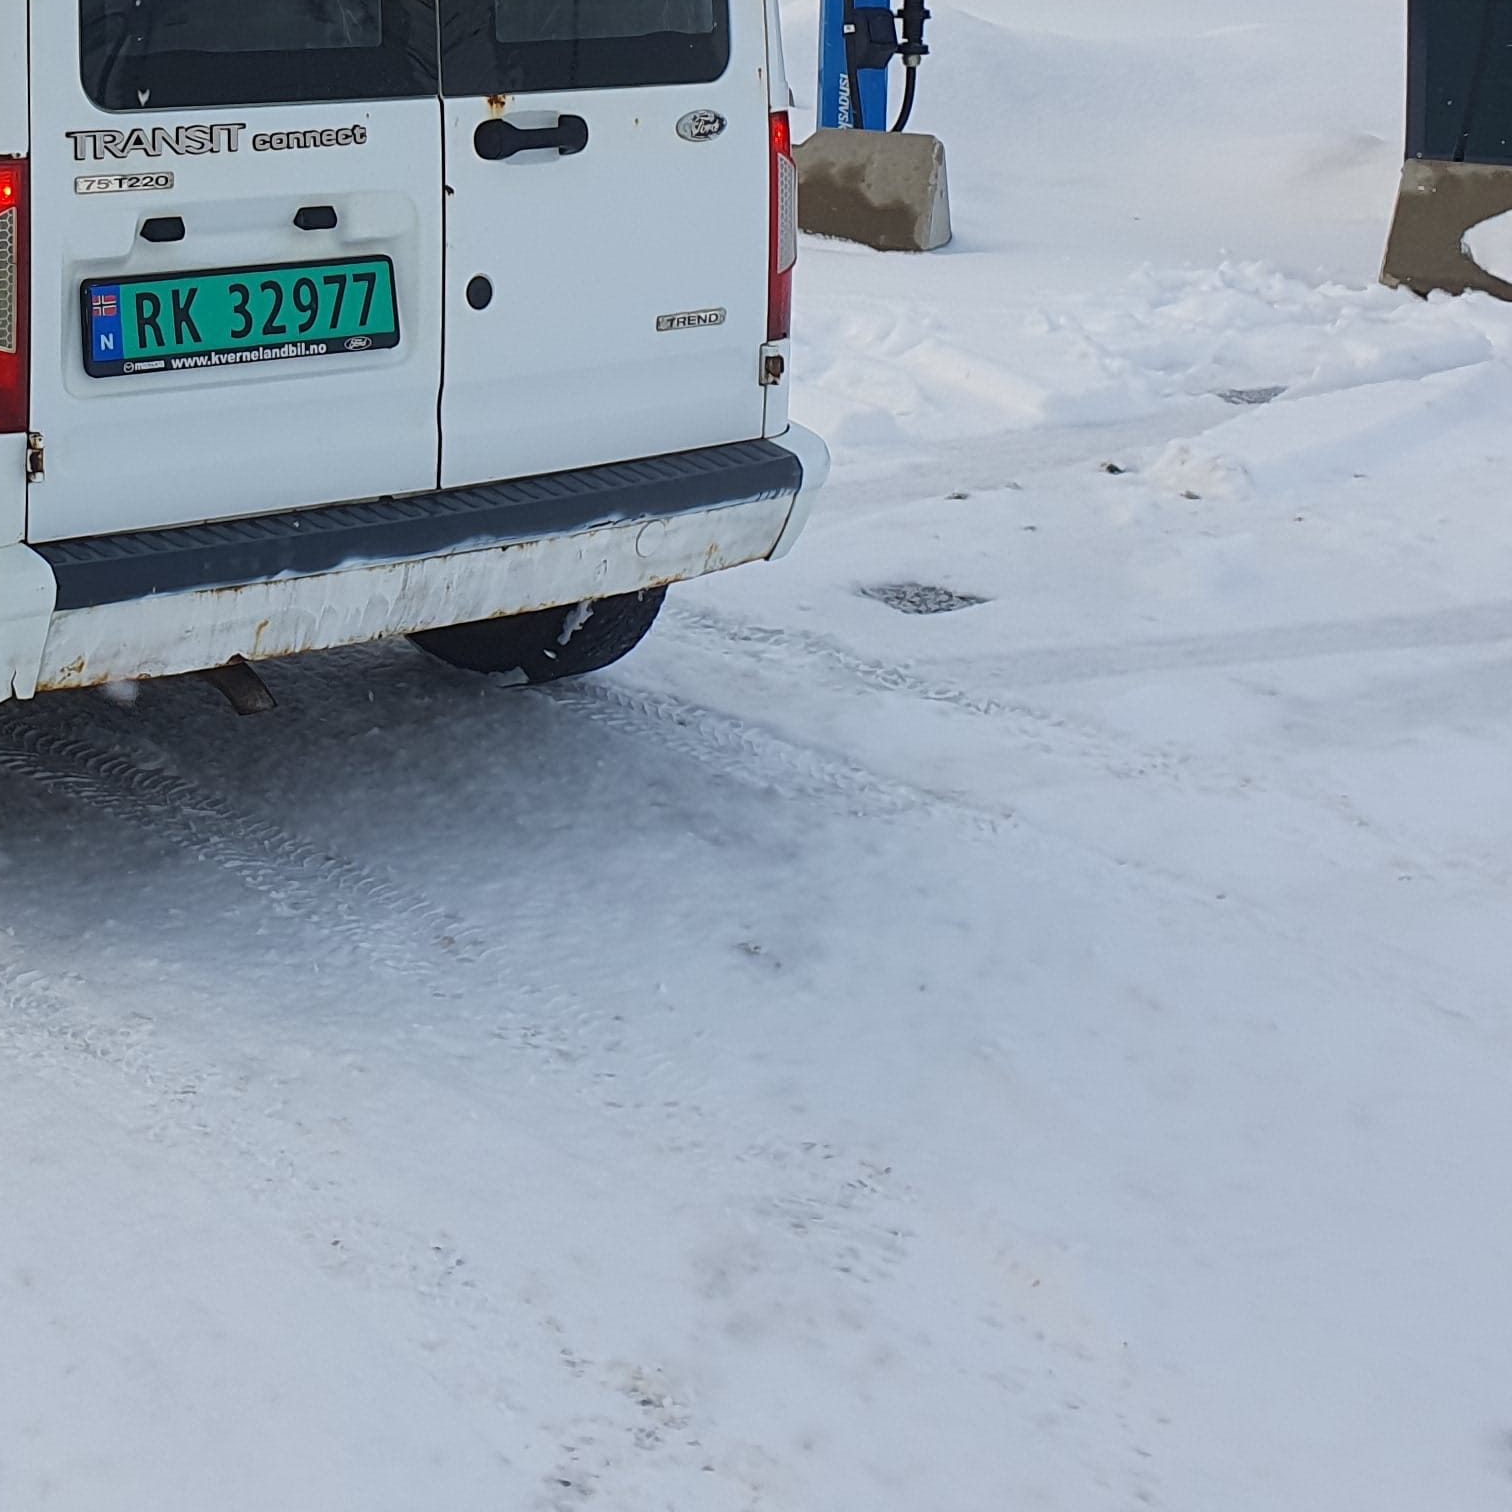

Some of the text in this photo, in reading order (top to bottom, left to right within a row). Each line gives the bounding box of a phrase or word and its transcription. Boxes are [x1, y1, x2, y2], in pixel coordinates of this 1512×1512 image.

[65, 123, 368, 161] TRANSIT connect
[135, 272, 377, 349] RK 32977
[667, 312, 719, 329] TREND
[100, 333, 114, 350] N
[171, 342, 327, 369] www.kvernelandbil.no
